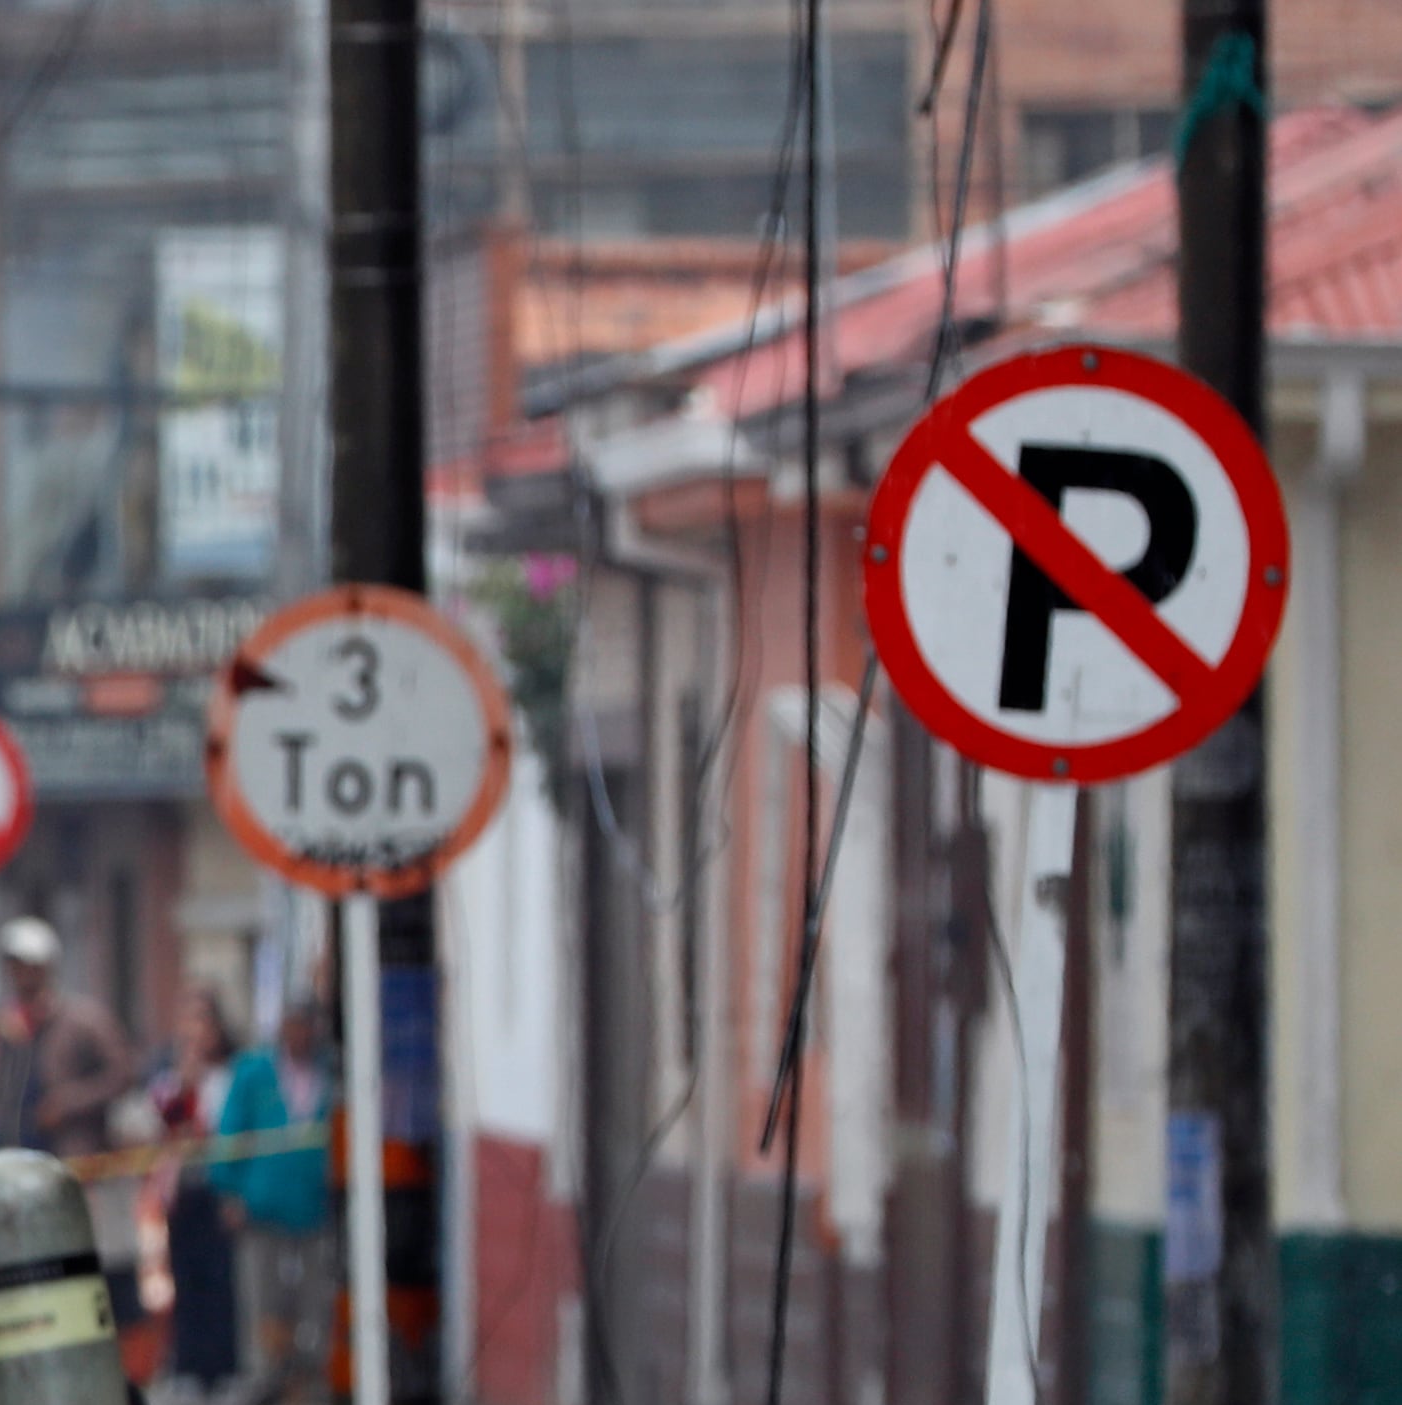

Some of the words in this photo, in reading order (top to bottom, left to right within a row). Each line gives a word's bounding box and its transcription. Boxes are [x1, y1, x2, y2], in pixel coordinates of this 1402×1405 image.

[998, 441, 1198, 714] P
[333, 637, 379, 723] 3
[275, 733, 437, 816] Ton
